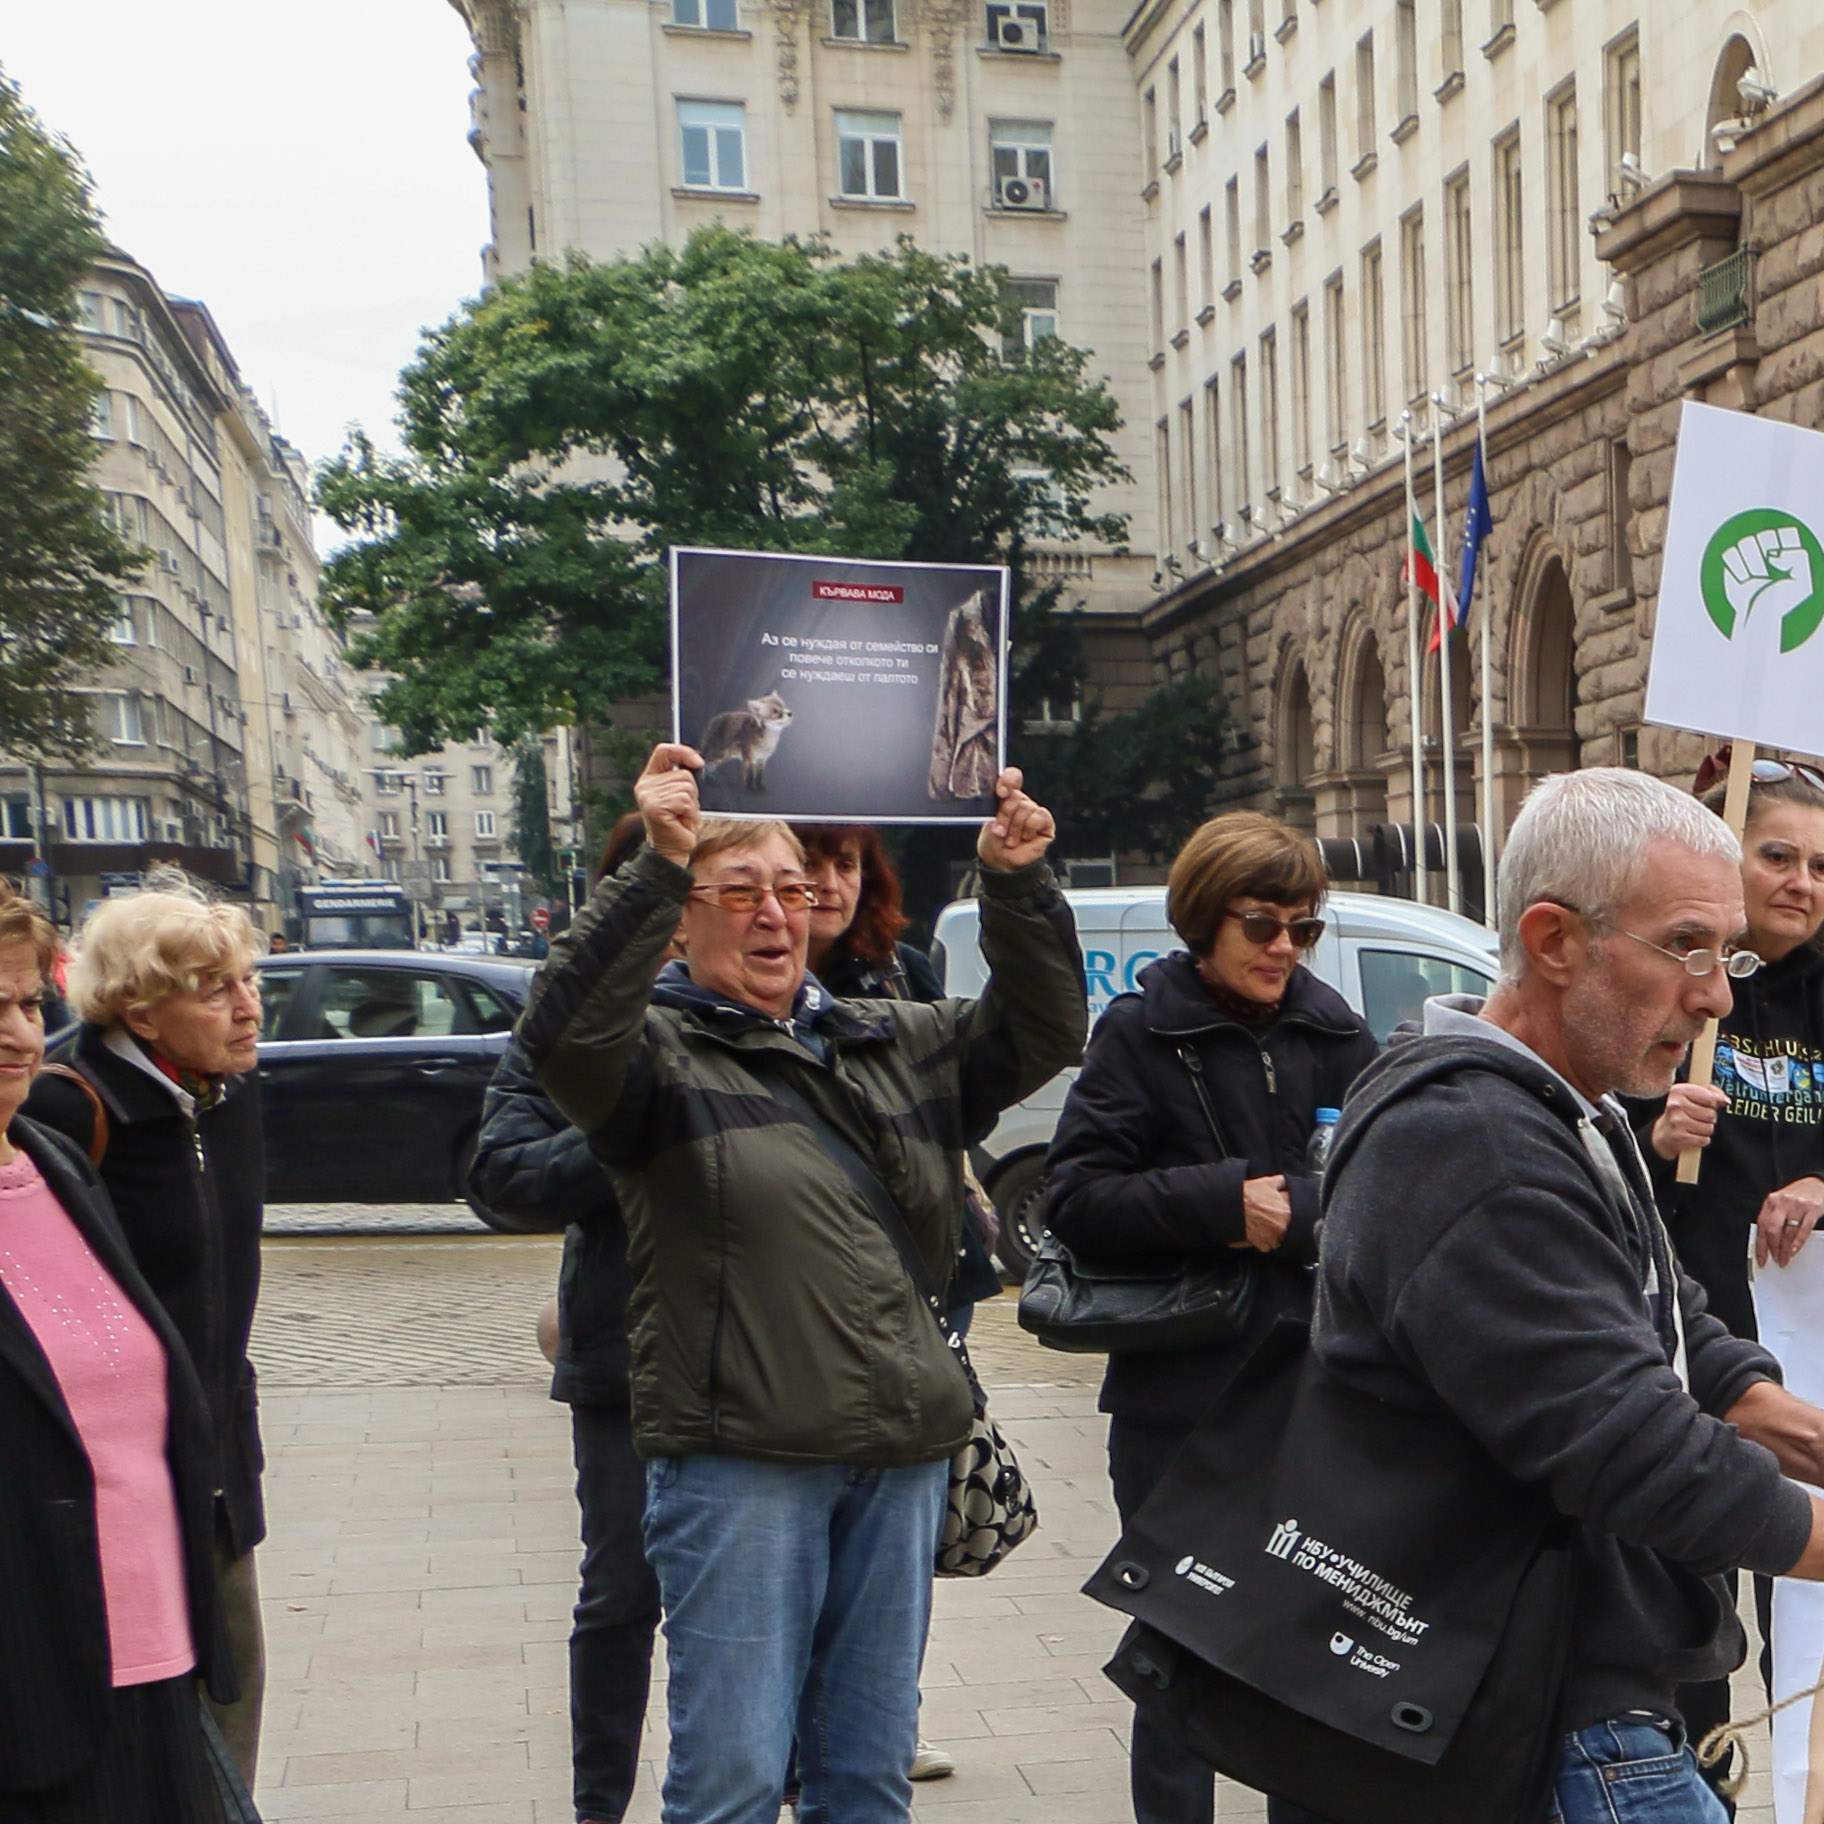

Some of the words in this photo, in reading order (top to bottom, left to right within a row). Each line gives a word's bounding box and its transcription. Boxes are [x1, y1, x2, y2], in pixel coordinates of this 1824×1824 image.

[819, 586, 866, 599] КЪРВАВА
[868, 590, 895, 600] МОДА
[761, 633, 778, 646] Аз
[782, 636, 797, 647] се
[801, 637, 847, 651] нуждая
[849, 641, 863, 651] от
[866, 641, 923, 653] семейство
[925, 644, 939, 653] си
[789, 653, 833, 665] повече
[836, 656, 893, 667] отколкото
[896, 658, 909, 668] ти
[781, 668, 796, 679] се
[800, 670, 855, 683] нуждаеш
[857, 672, 870, 682] от
[873, 674, 918, 684] палтото
[1291, 1551, 1316, 1570] ПО
[1314, 1562, 1429, 1635] МЕНИДЖМЪНТ
[1357, 1645, 1373, 1661] The
[1374, 1655, 1400, 1671] Open
